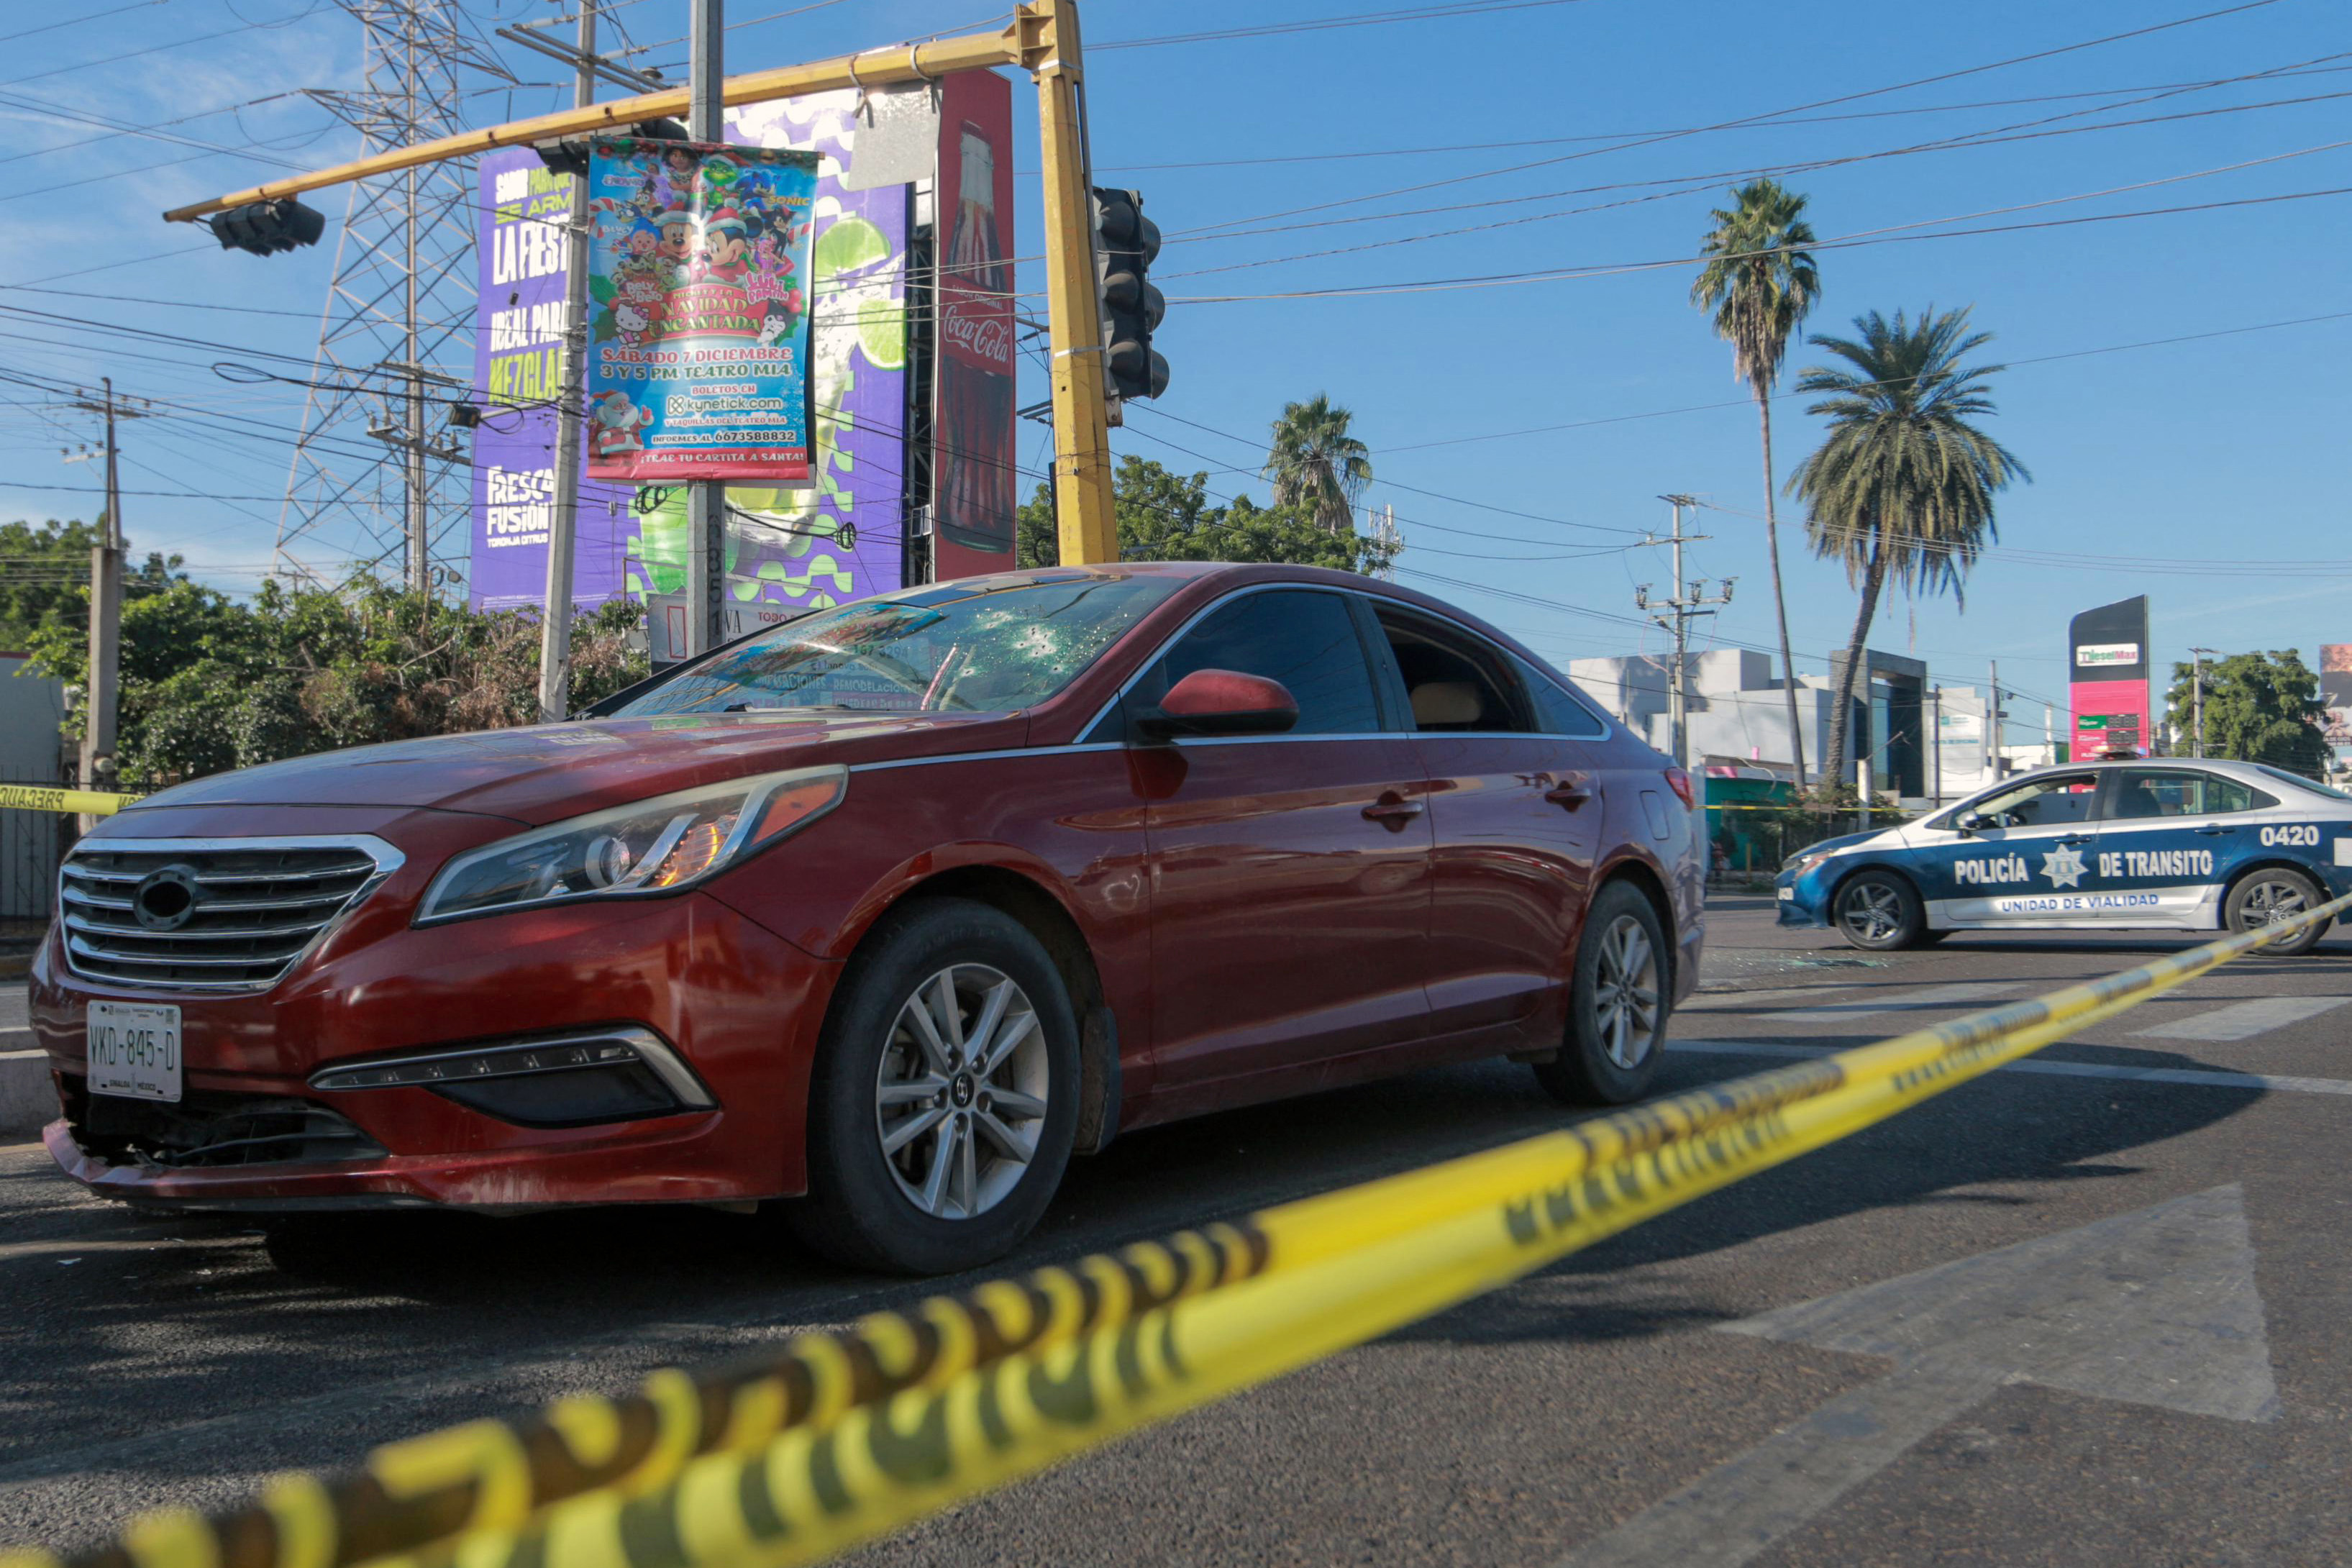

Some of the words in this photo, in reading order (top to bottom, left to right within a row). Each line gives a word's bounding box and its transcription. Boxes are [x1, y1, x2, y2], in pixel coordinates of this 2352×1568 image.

[496, 203, 523, 224] SE
[527, 191, 573, 217] ARM
[770, 196, 811, 206] SONIC
[493, 224, 516, 285] LA
[519, 214, 570, 280] FIEST
[660, 298, 748, 316] NAVIDAD
[975, 294, 1003, 311] ORIGINAL
[491, 307, 529, 352] IDEAL
[649, 314, 761, 338] ENCANTADA
[602, 346, 678, 363] SÁBADO
[683, 352, 690, 363] 7
[696, 348, 793, 363] DICIEMBRE
[488, 347, 562, 406] MEZCLA
[601, 365, 613, 377] 3
[618, 366, 629, 378] Y
[634, 368, 646, 379] 5
[650, 368, 678, 379] PM
[685, 365, 749, 378] TEATRO
[754, 363, 791, 376] MIA
[692, 386, 739, 395] BOLETOS
[741, 385, 756, 393] EN
[687, 397, 782, 412] kynetick.com
[671, 418, 714, 427] TAQUILLAS
[715, 432, 795, 442] 6673588832
[696, 453, 746, 462] CARTITA
[761, 452, 804, 461] SANTA!
[488, 466, 554, 505] FRESCA
[758, 611, 787, 623] TODO
[833, 678, 923, 695] REMODELACION
[2260, 825, 2320, 847] 0420
[1954, 852, 2029, 885] POLICÍA
[2099, 852, 2123, 878] DE
[2125, 849, 2213, 877] TRANSITO
[2002, 898, 2058, 912] UNIDAD
[2063, 898, 2082, 909] DE
[2088, 894, 2159, 908] VIALIDAD
[89, 1026, 175, 1071] VKD-845-D
[109, 1080, 130, 1088] SINALOA
